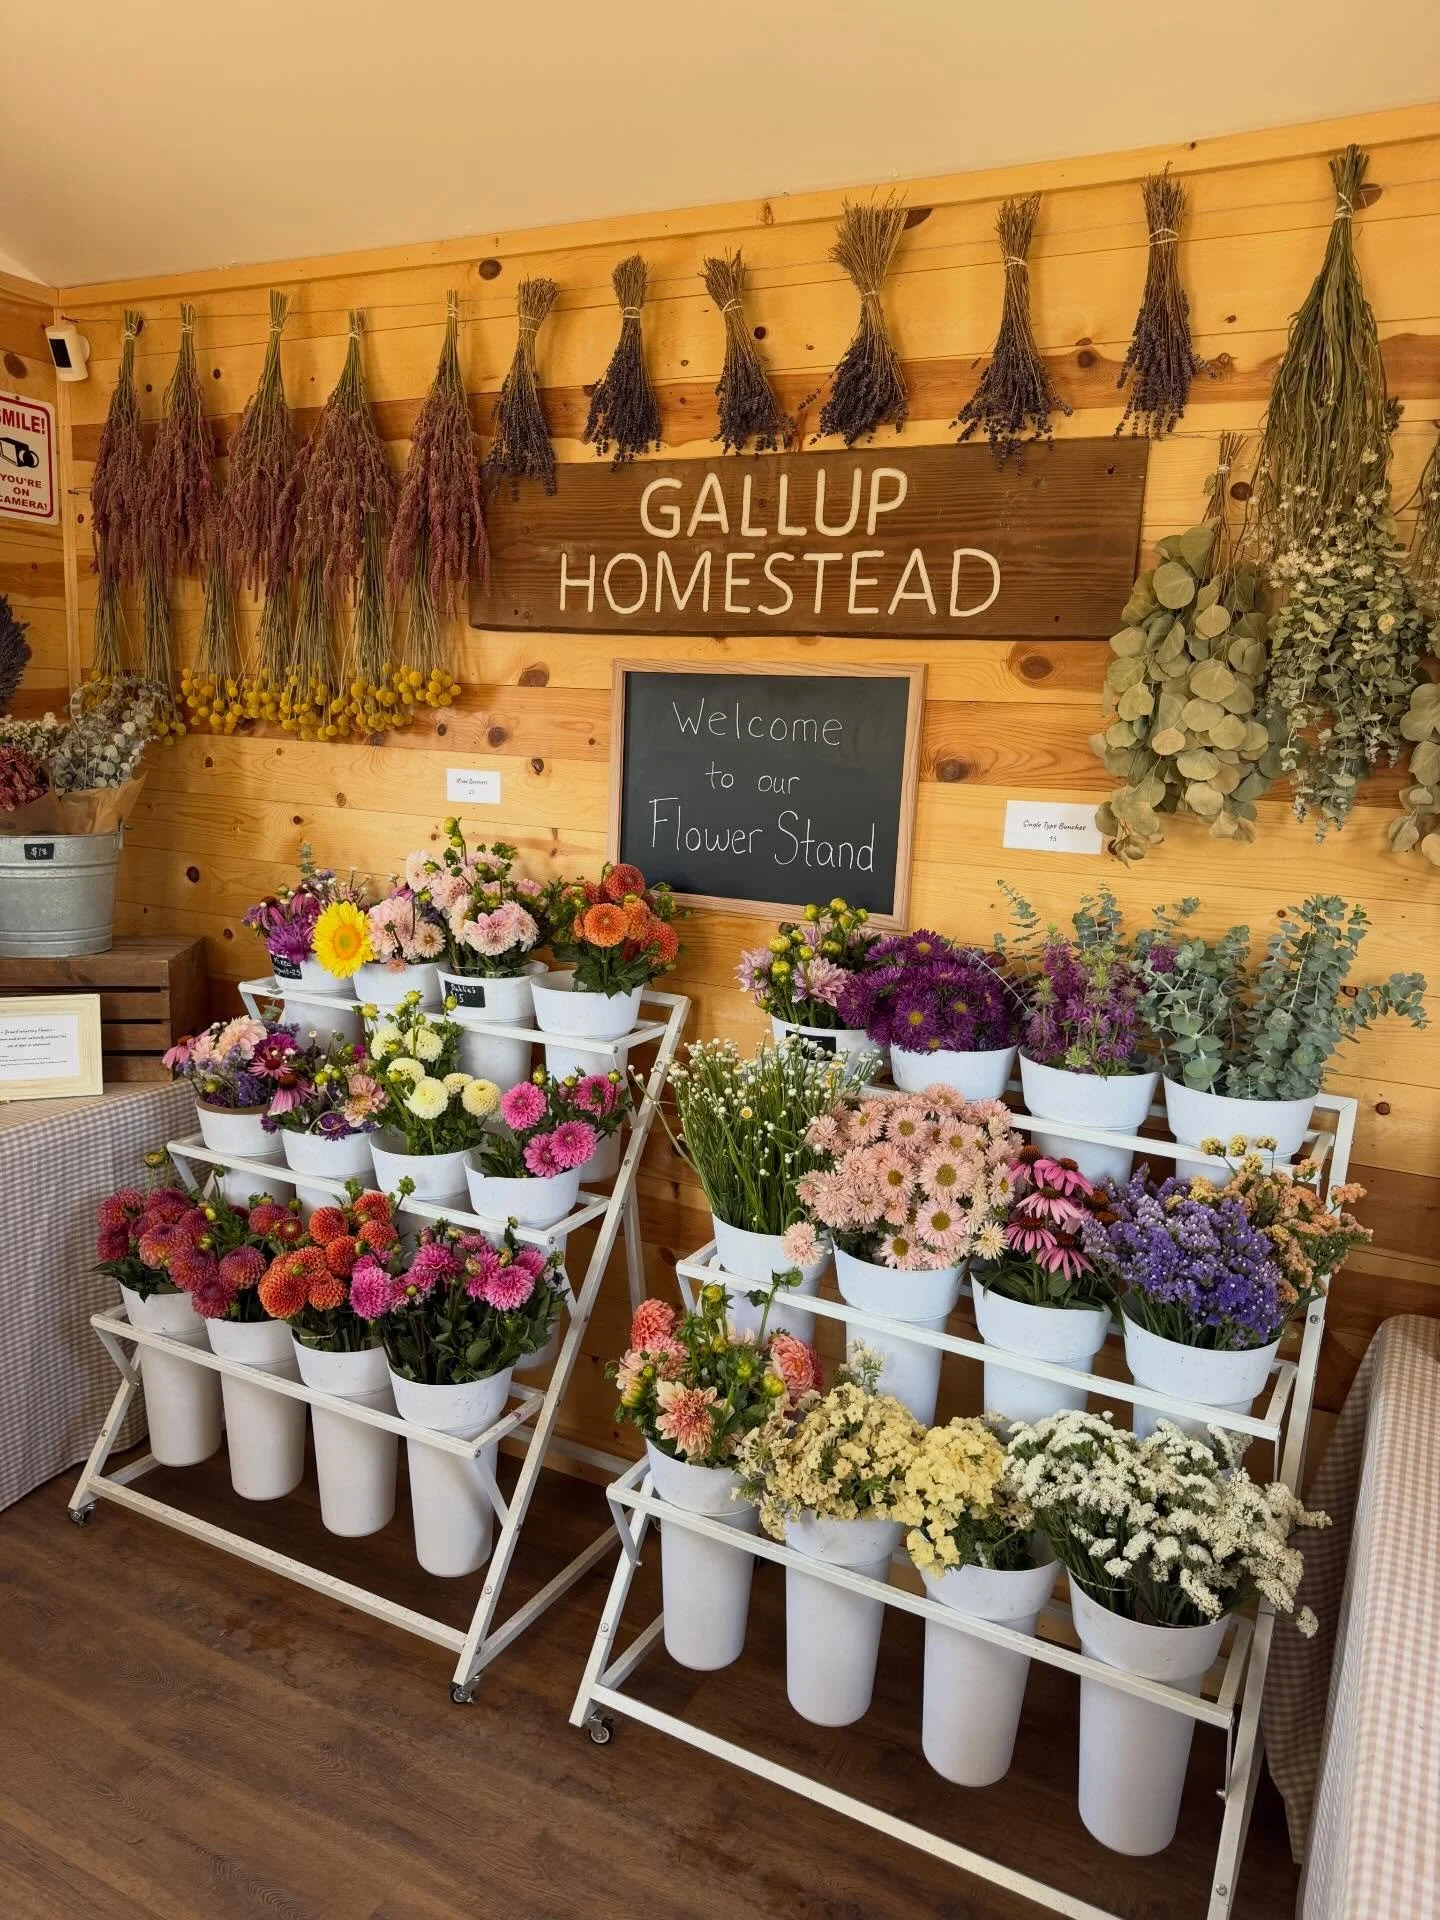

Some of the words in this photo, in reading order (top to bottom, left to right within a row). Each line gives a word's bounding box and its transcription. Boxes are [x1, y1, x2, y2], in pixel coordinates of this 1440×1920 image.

[0, 408, 45, 434] MILE!
[0, 474, 42, 488] YOU'RE
[13, 487, 29, 496] ON
[640, 467, 907, 538] GALLUP
[559, 548, 1000, 617] HOMESTEAD
[672, 698, 843, 745] Welcome
[705, 761, 734, 789] to
[758, 775, 800, 794] our
[649, 798, 763, 854] Flower
[774, 810, 875, 872] Stand
